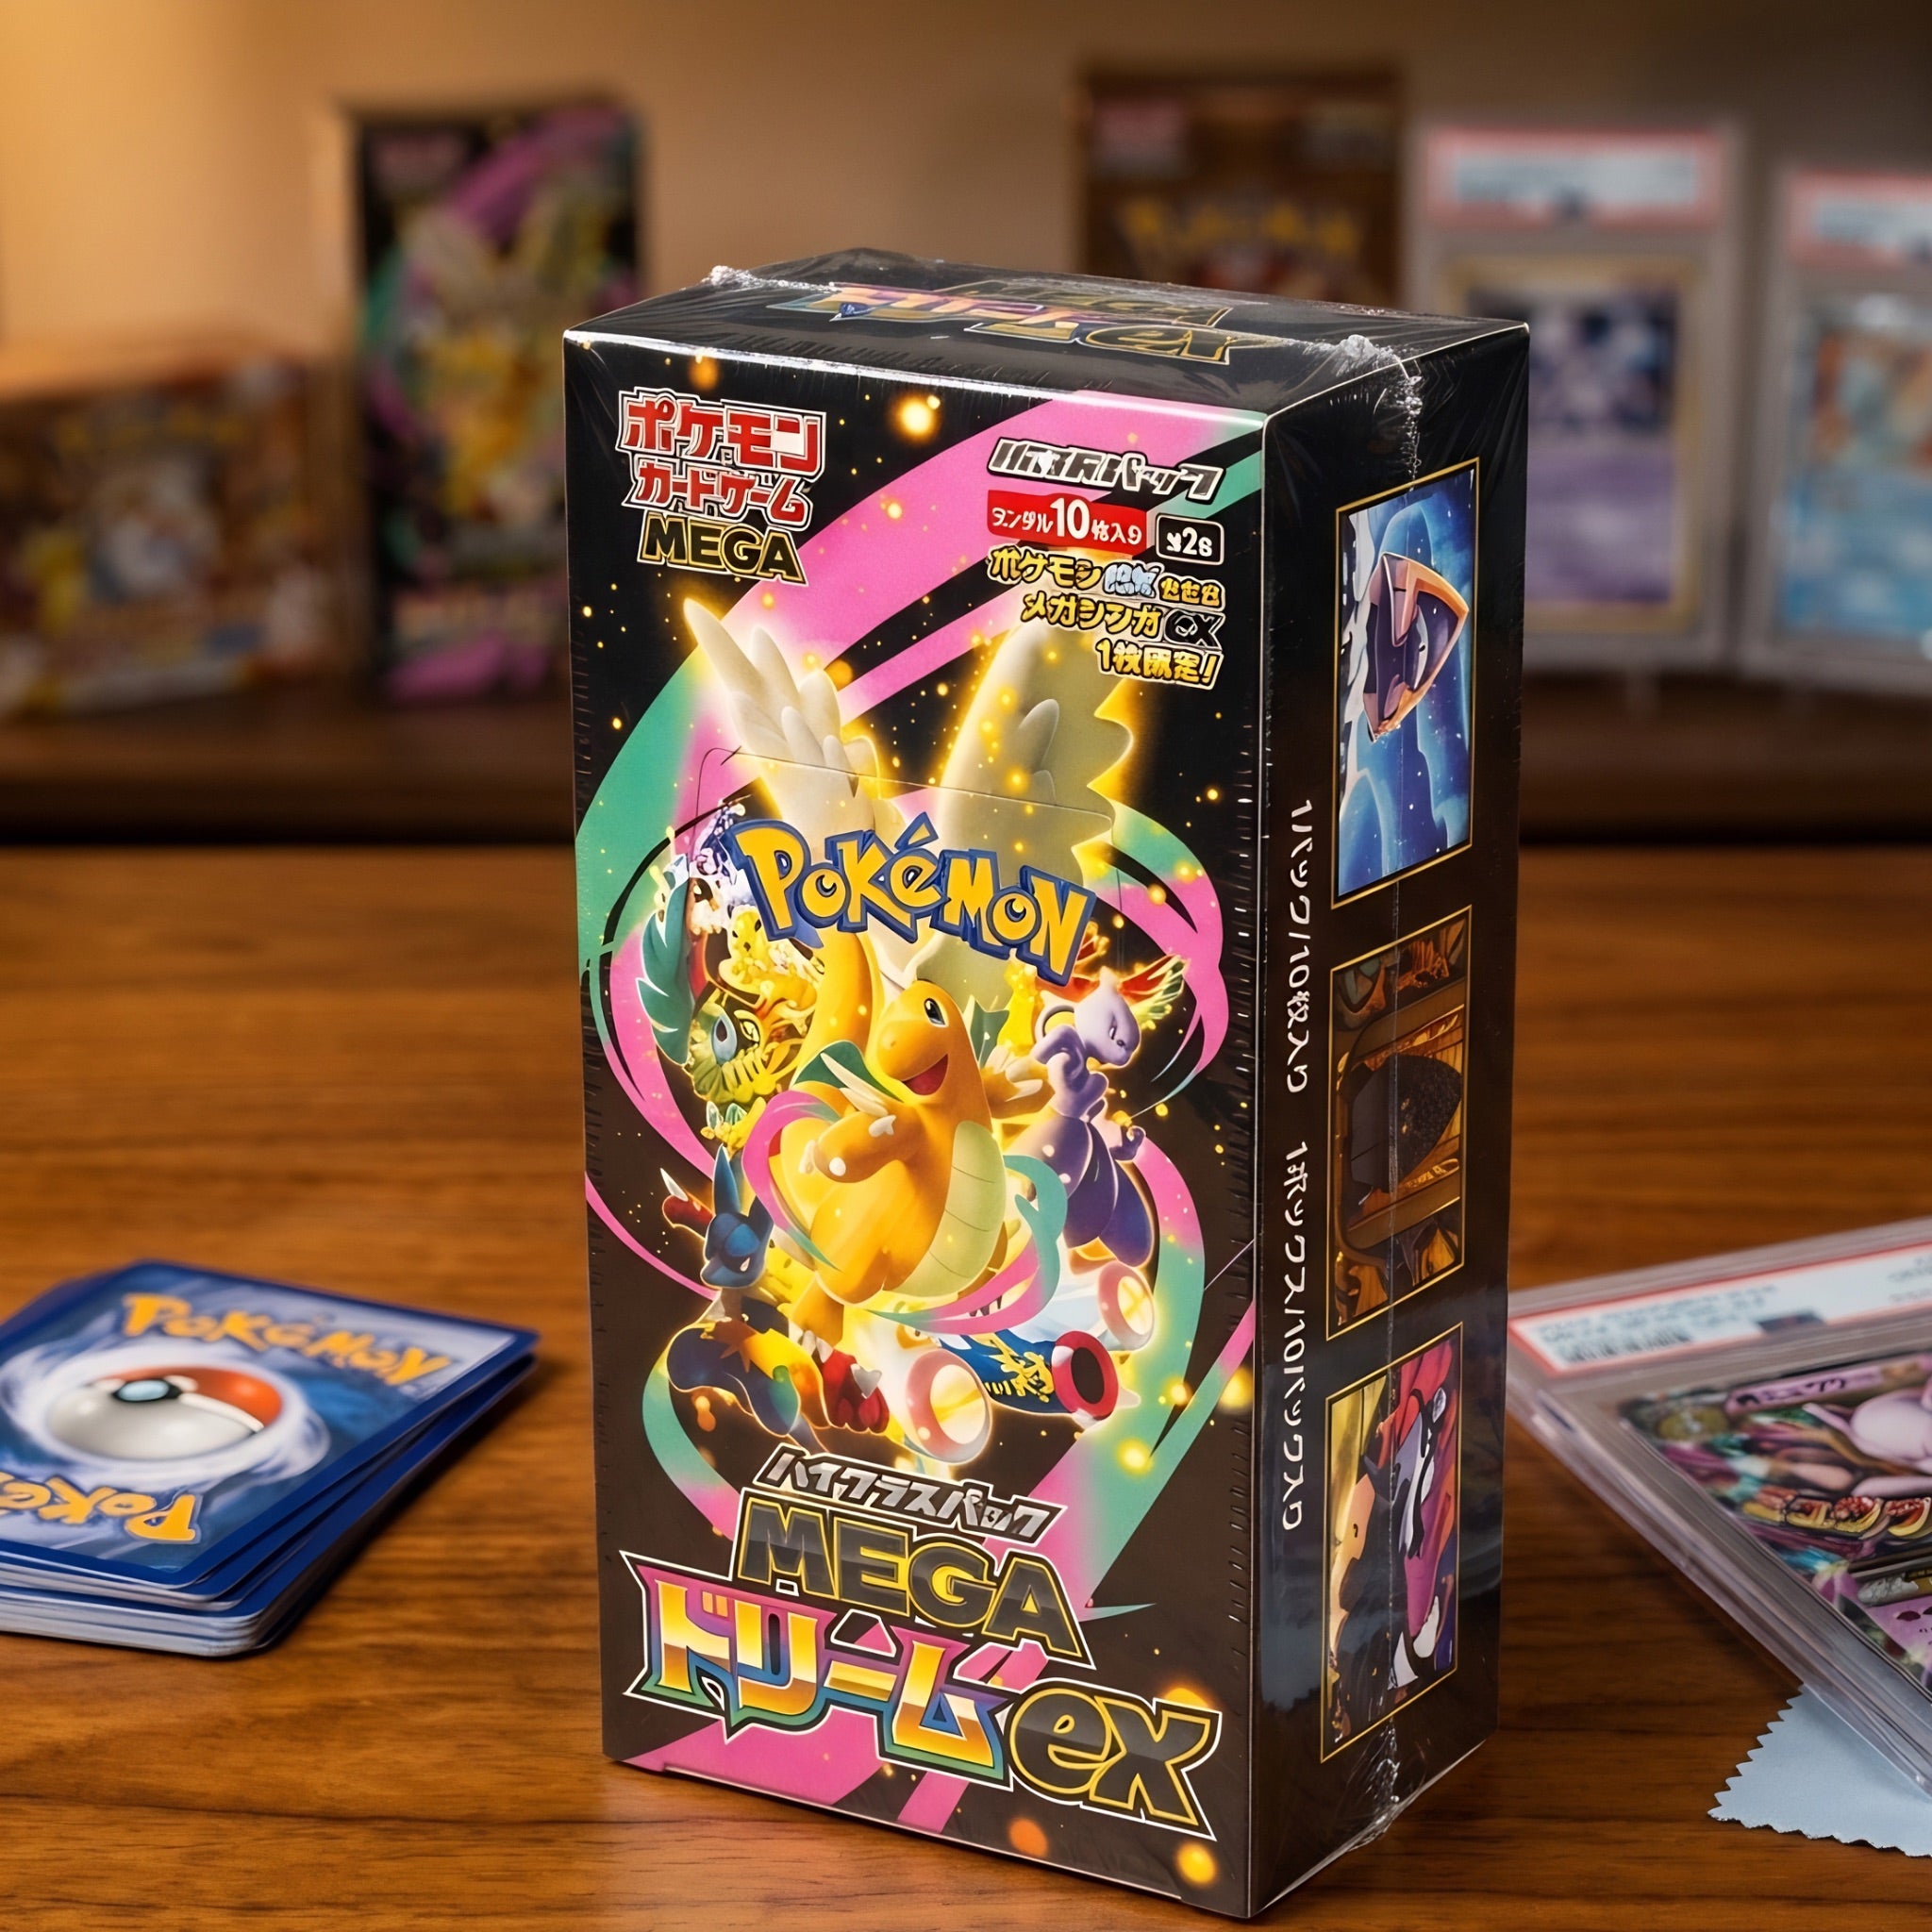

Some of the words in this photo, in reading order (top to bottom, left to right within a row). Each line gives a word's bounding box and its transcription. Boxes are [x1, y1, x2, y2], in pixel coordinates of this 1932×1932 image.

[618, 388, 825, 481] ポケモン
[626, 458, 812, 529] カードゲーム
[639, 512, 808, 585] MEGA
[733, 1492, 1089, 1662] MEGA
